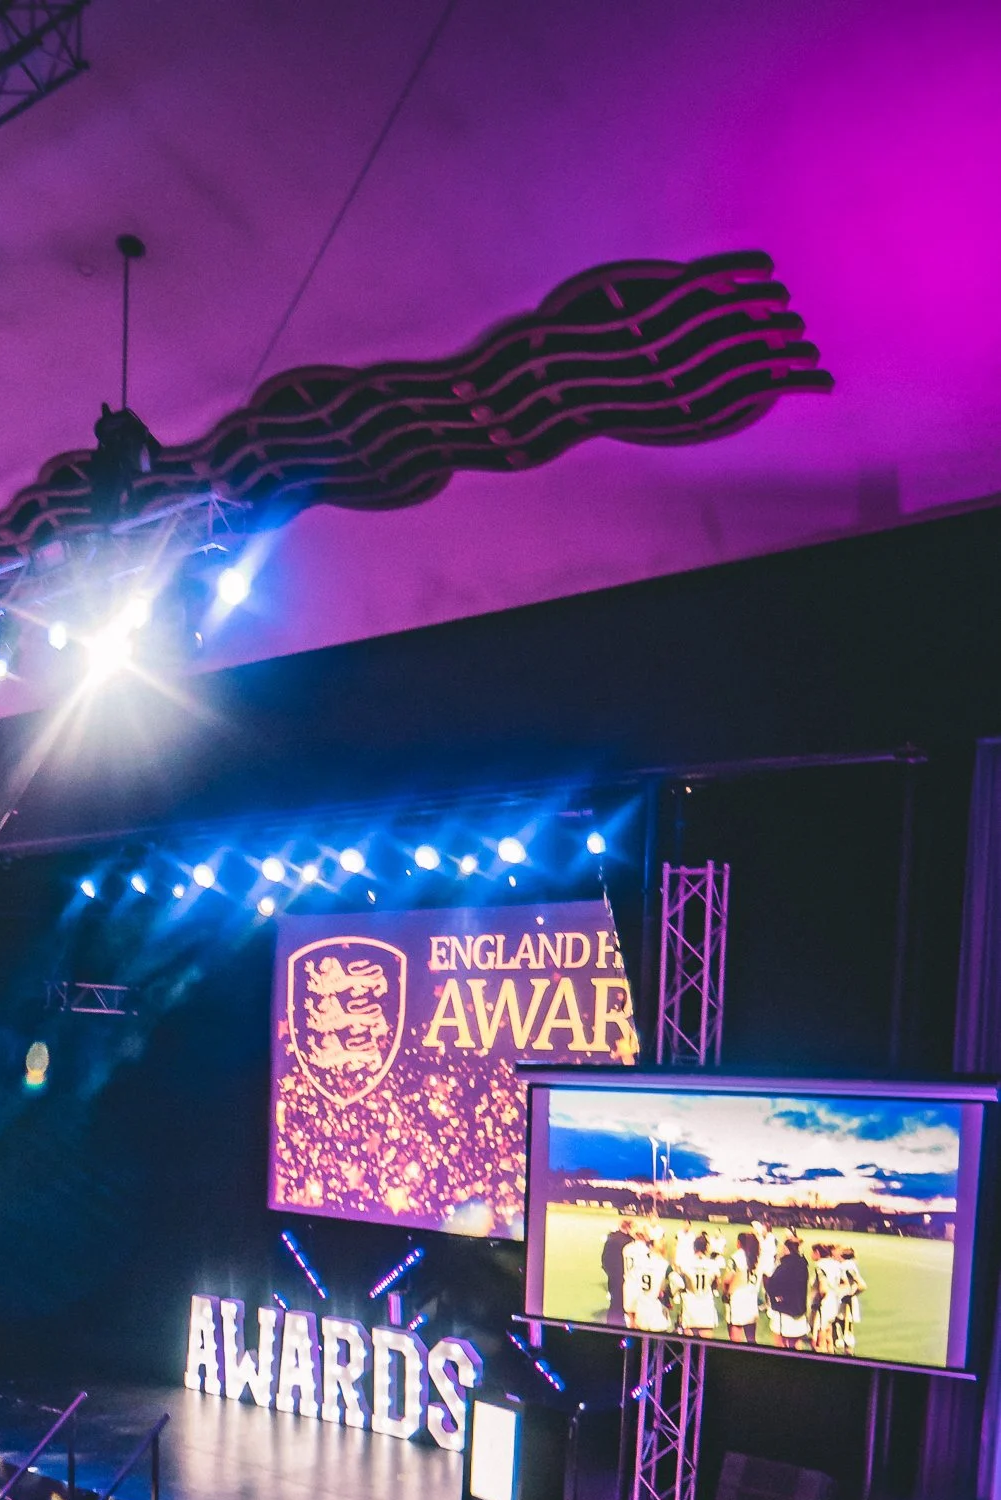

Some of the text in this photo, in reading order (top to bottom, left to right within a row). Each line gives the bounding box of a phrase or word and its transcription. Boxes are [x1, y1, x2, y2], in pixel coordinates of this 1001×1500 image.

[429, 931, 591, 971] ENGLAND
[423, 977, 639, 1052] AWAR
[641, 1274, 652, 1292] 9
[695, 1274, 706, 1290] 11
[185, 1295, 483, 1452] AWARDS
